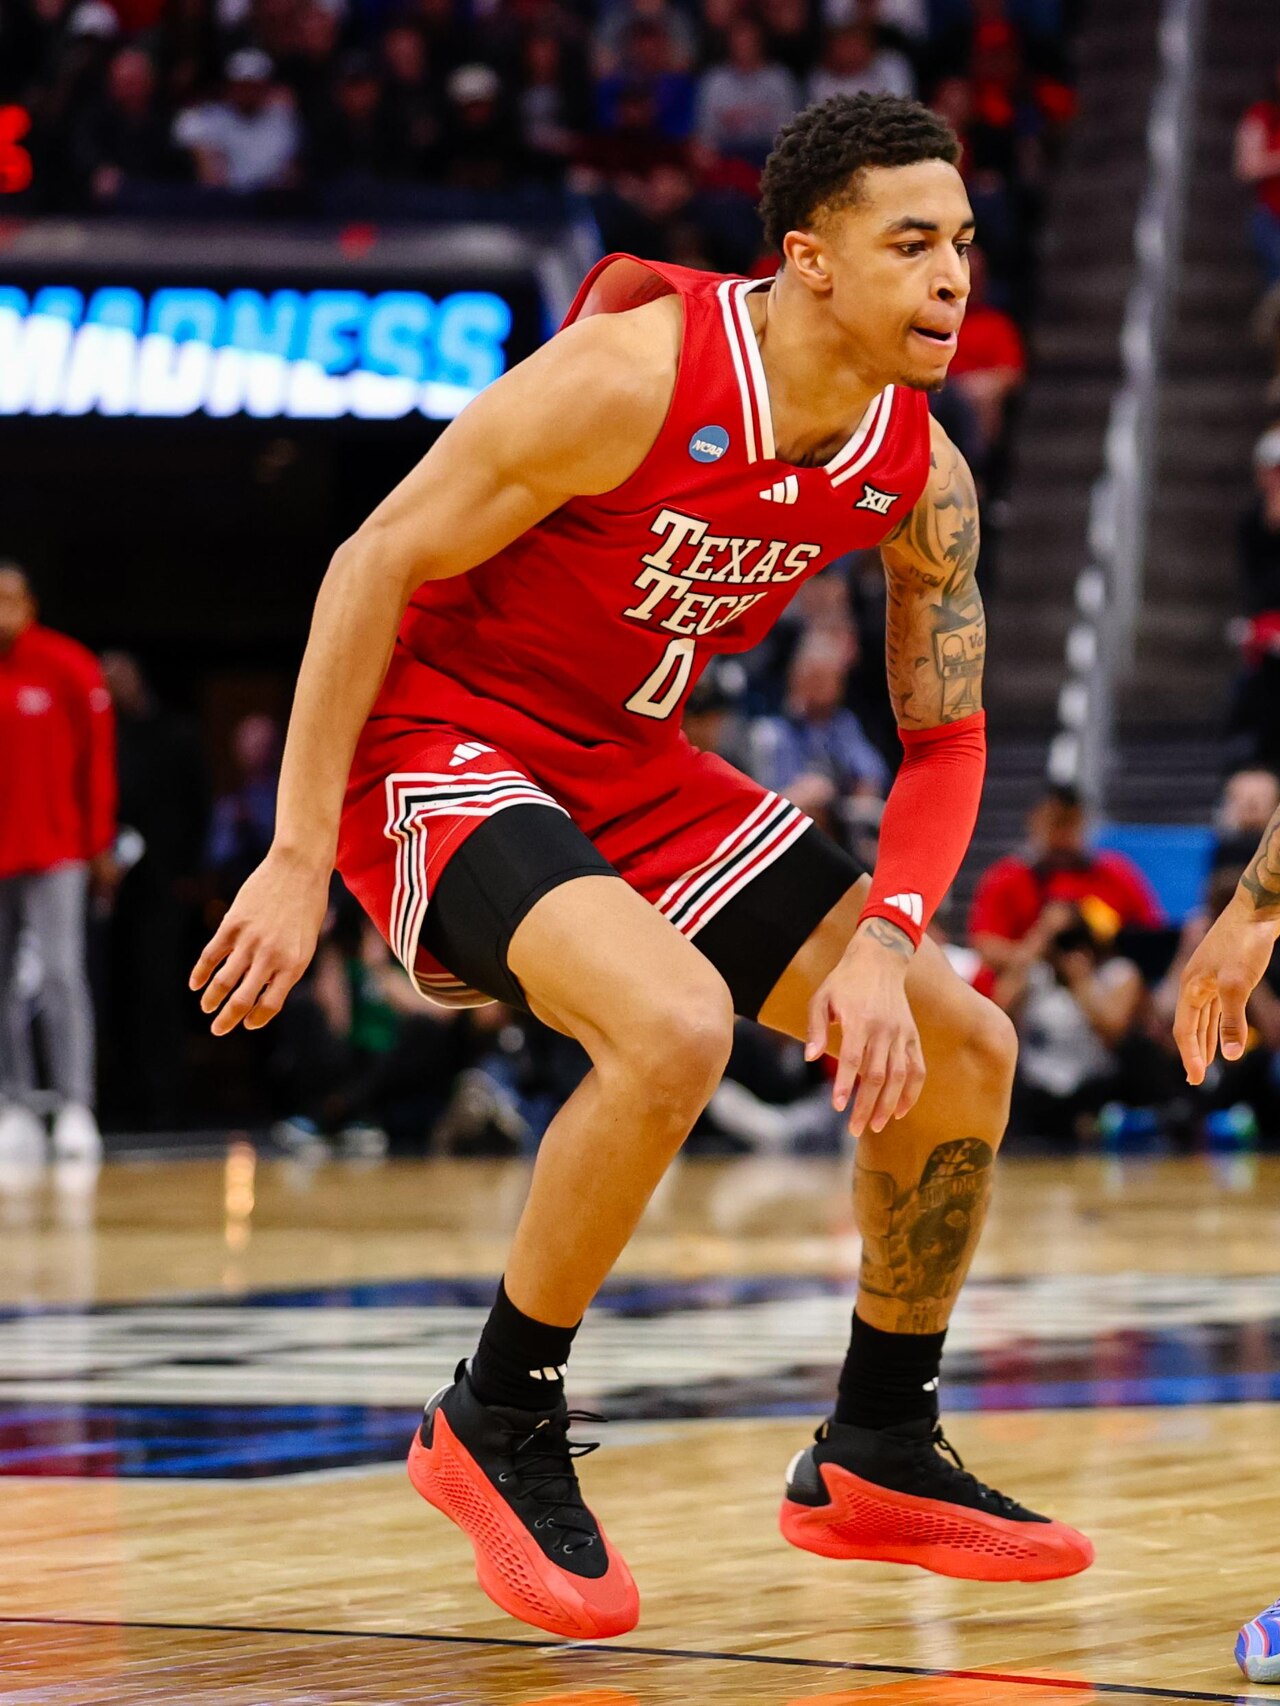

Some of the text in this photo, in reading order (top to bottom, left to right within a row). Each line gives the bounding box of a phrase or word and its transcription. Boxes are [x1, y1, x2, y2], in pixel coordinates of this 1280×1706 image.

[641, 507, 821, 585] TEXAS
[622, 564, 769, 636] TECH
[624, 636, 696, 721] 0
